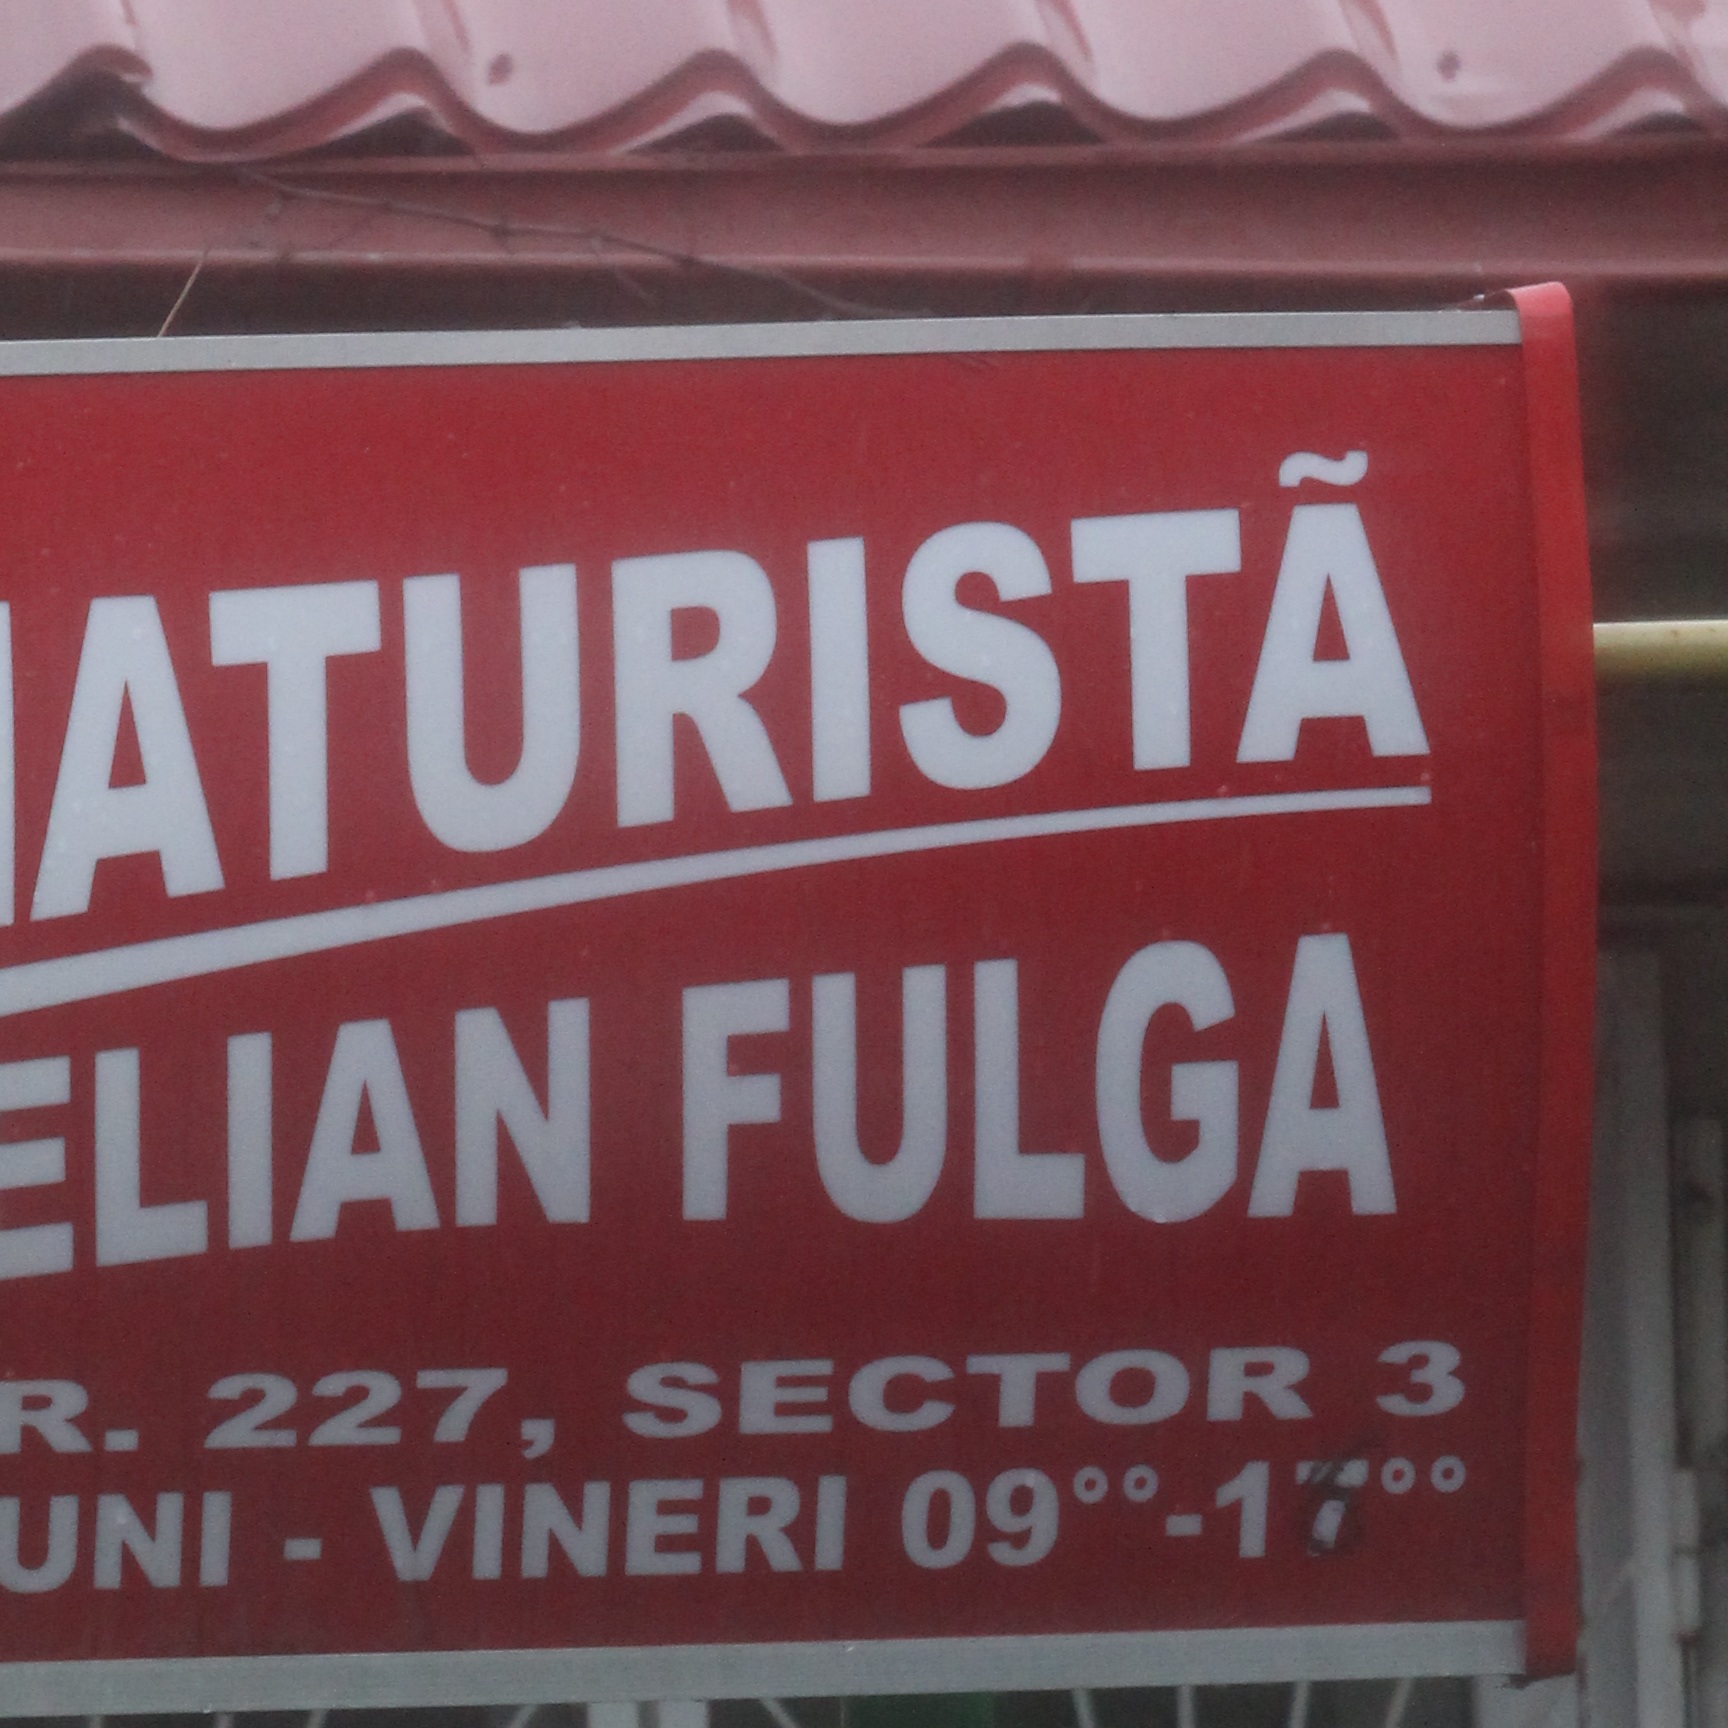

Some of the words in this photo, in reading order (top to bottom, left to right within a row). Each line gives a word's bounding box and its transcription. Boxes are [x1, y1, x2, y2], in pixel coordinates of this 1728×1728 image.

[680, 932, 1397, 1225] FULGA
[203, 1367, 556, 1460] 227,
[624, 1345, 1314, 1440] SECTOR
[1375, 1339, 1466, 1417] 3
[370, 1474, 848, 1583] VINERI
